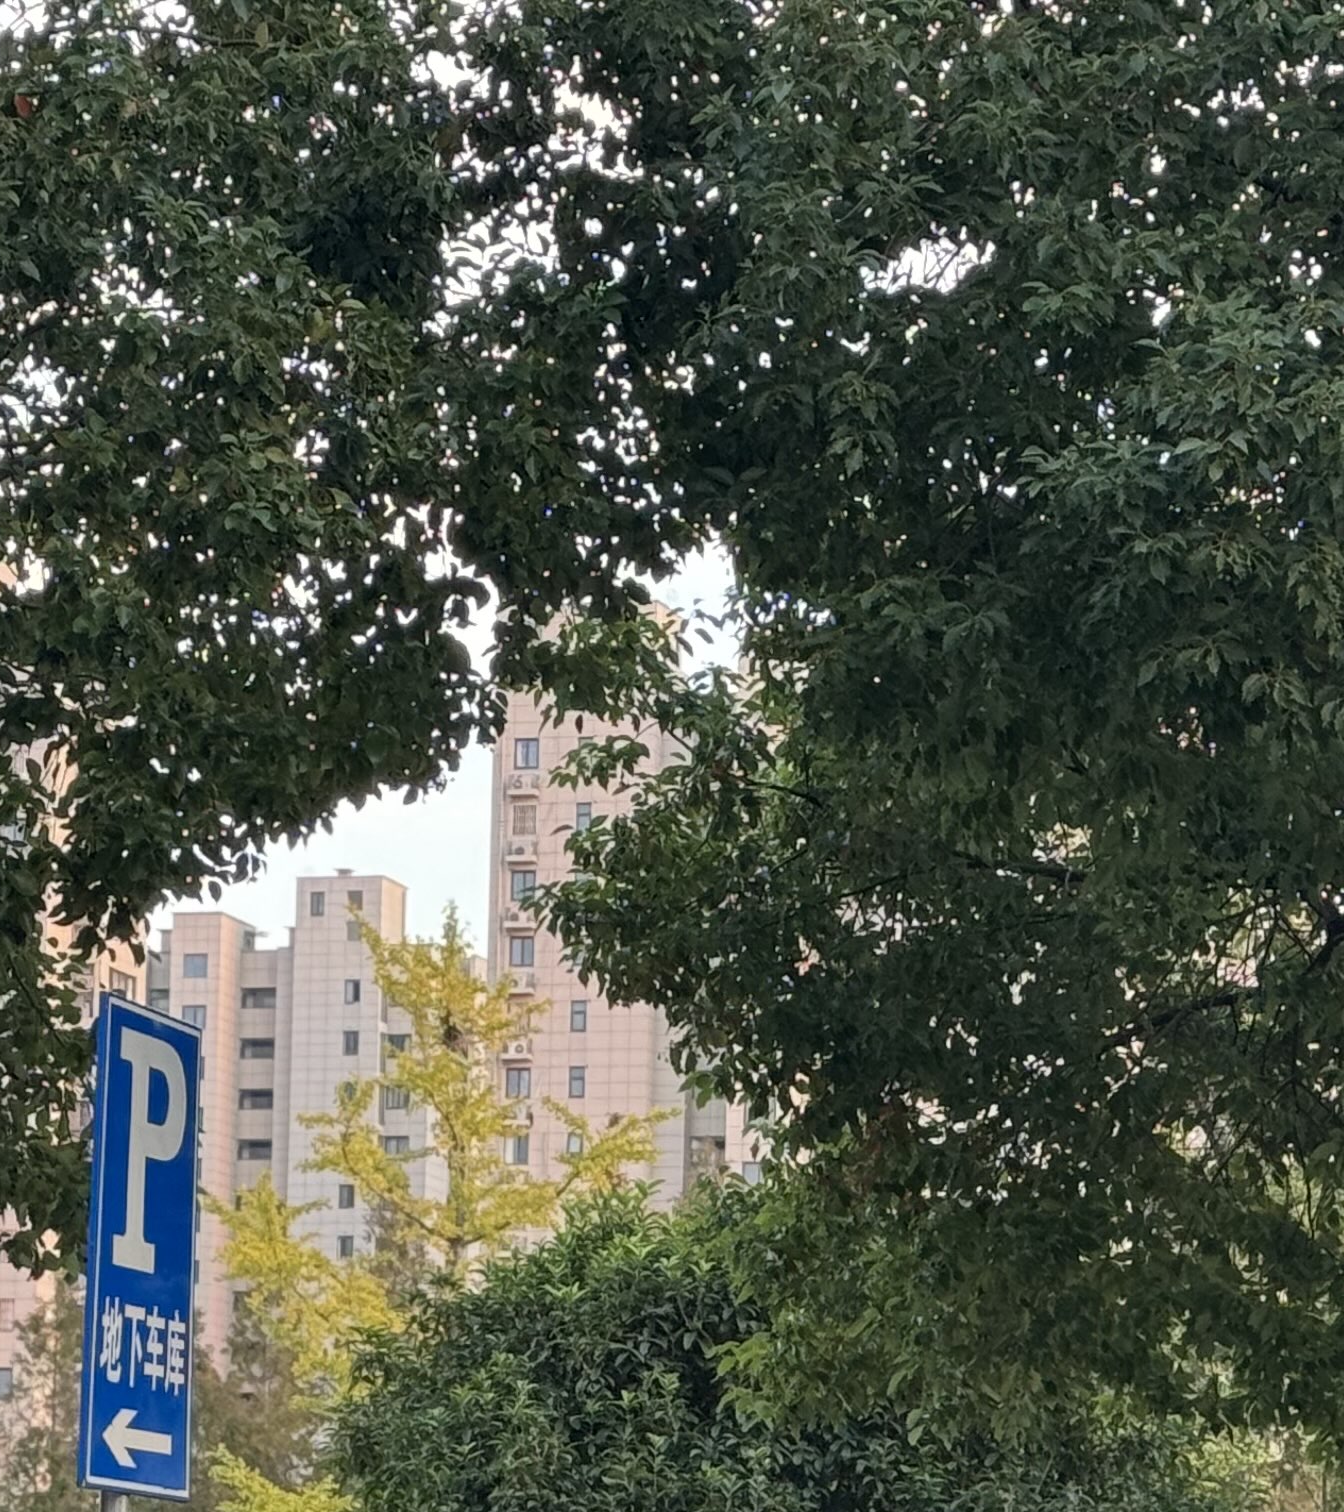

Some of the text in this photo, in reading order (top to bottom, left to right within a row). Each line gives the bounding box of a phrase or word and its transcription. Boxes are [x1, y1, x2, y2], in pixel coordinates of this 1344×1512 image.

[112, 1026, 187, 1275] P
[99, 1296, 186, 1396] 地下车库
